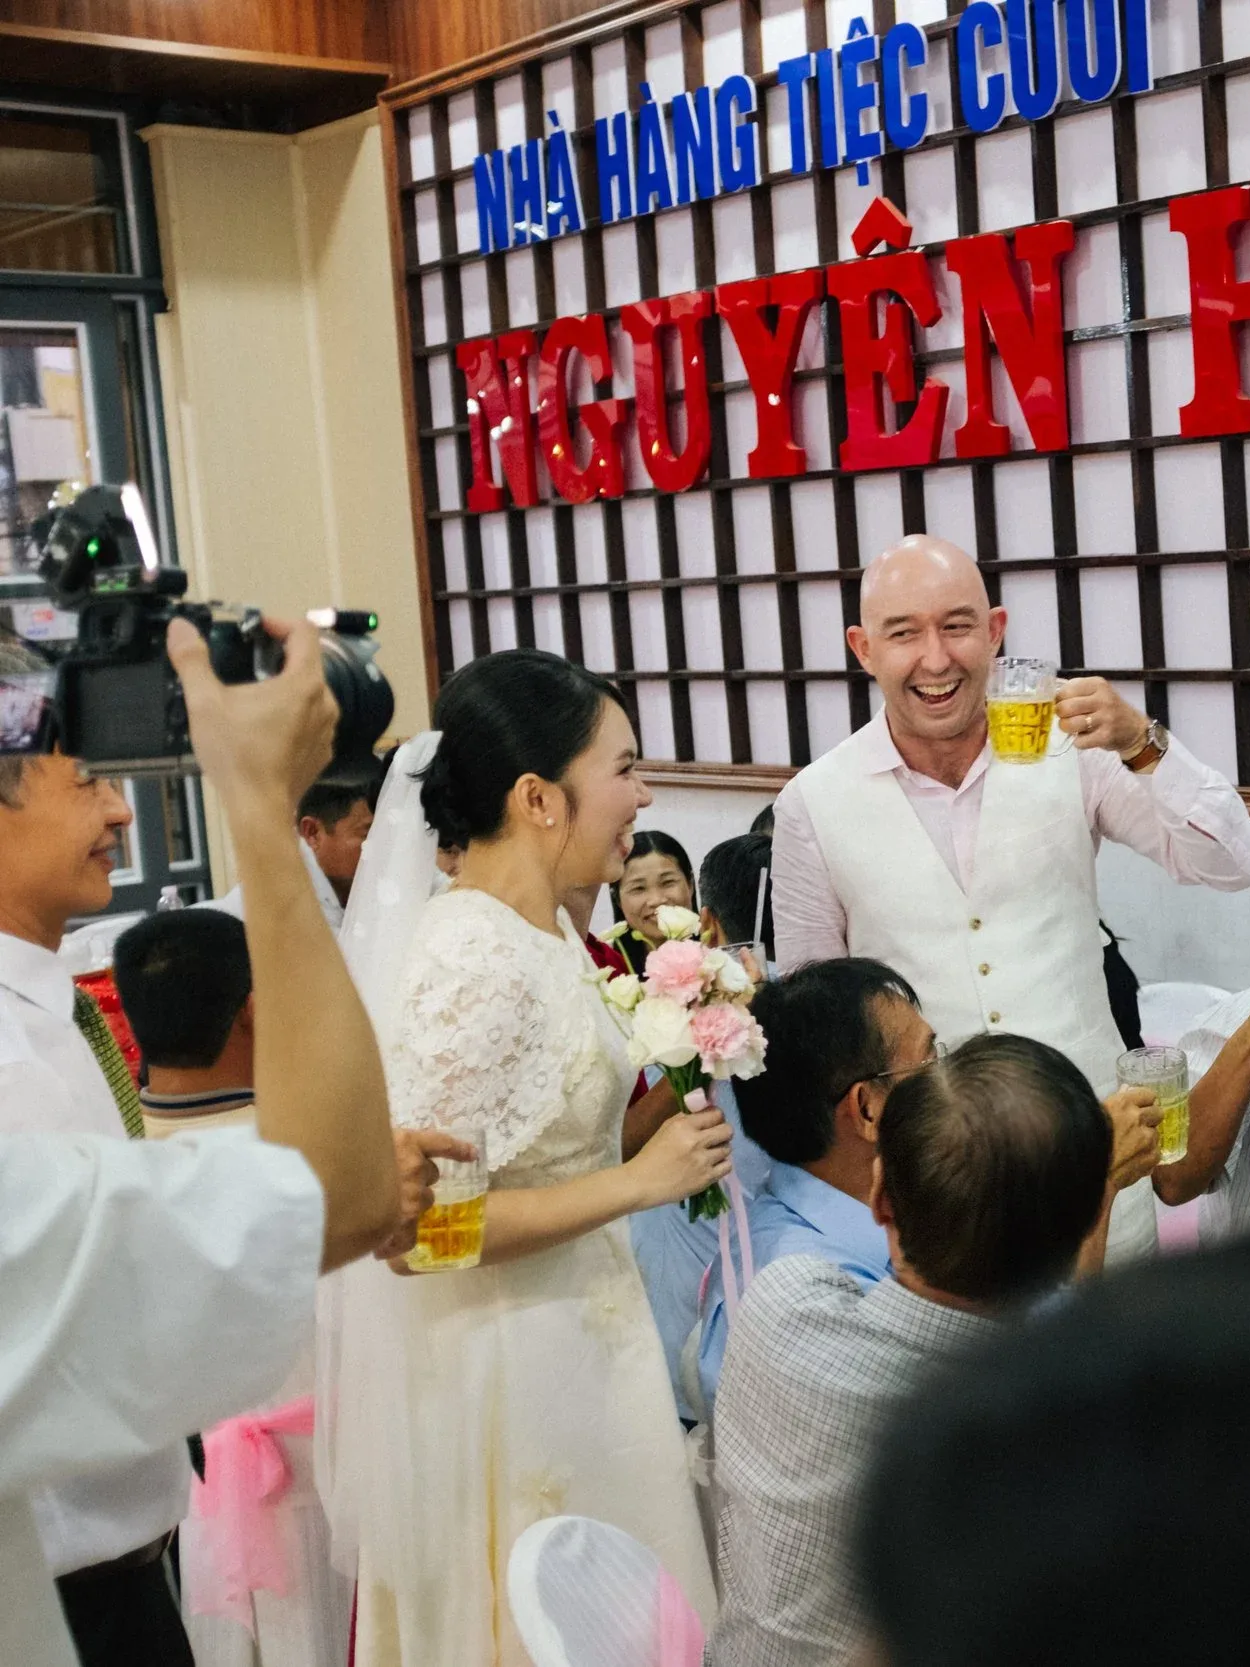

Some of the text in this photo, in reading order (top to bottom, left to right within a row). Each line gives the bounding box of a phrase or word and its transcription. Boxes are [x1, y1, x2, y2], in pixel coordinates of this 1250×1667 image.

[473, 110, 584, 254] NHÀ
[595, 74, 762, 225] HÀNG
[778, 16, 928, 186] TIỆC
[457, 197, 1076, 514] NGUYÊN
